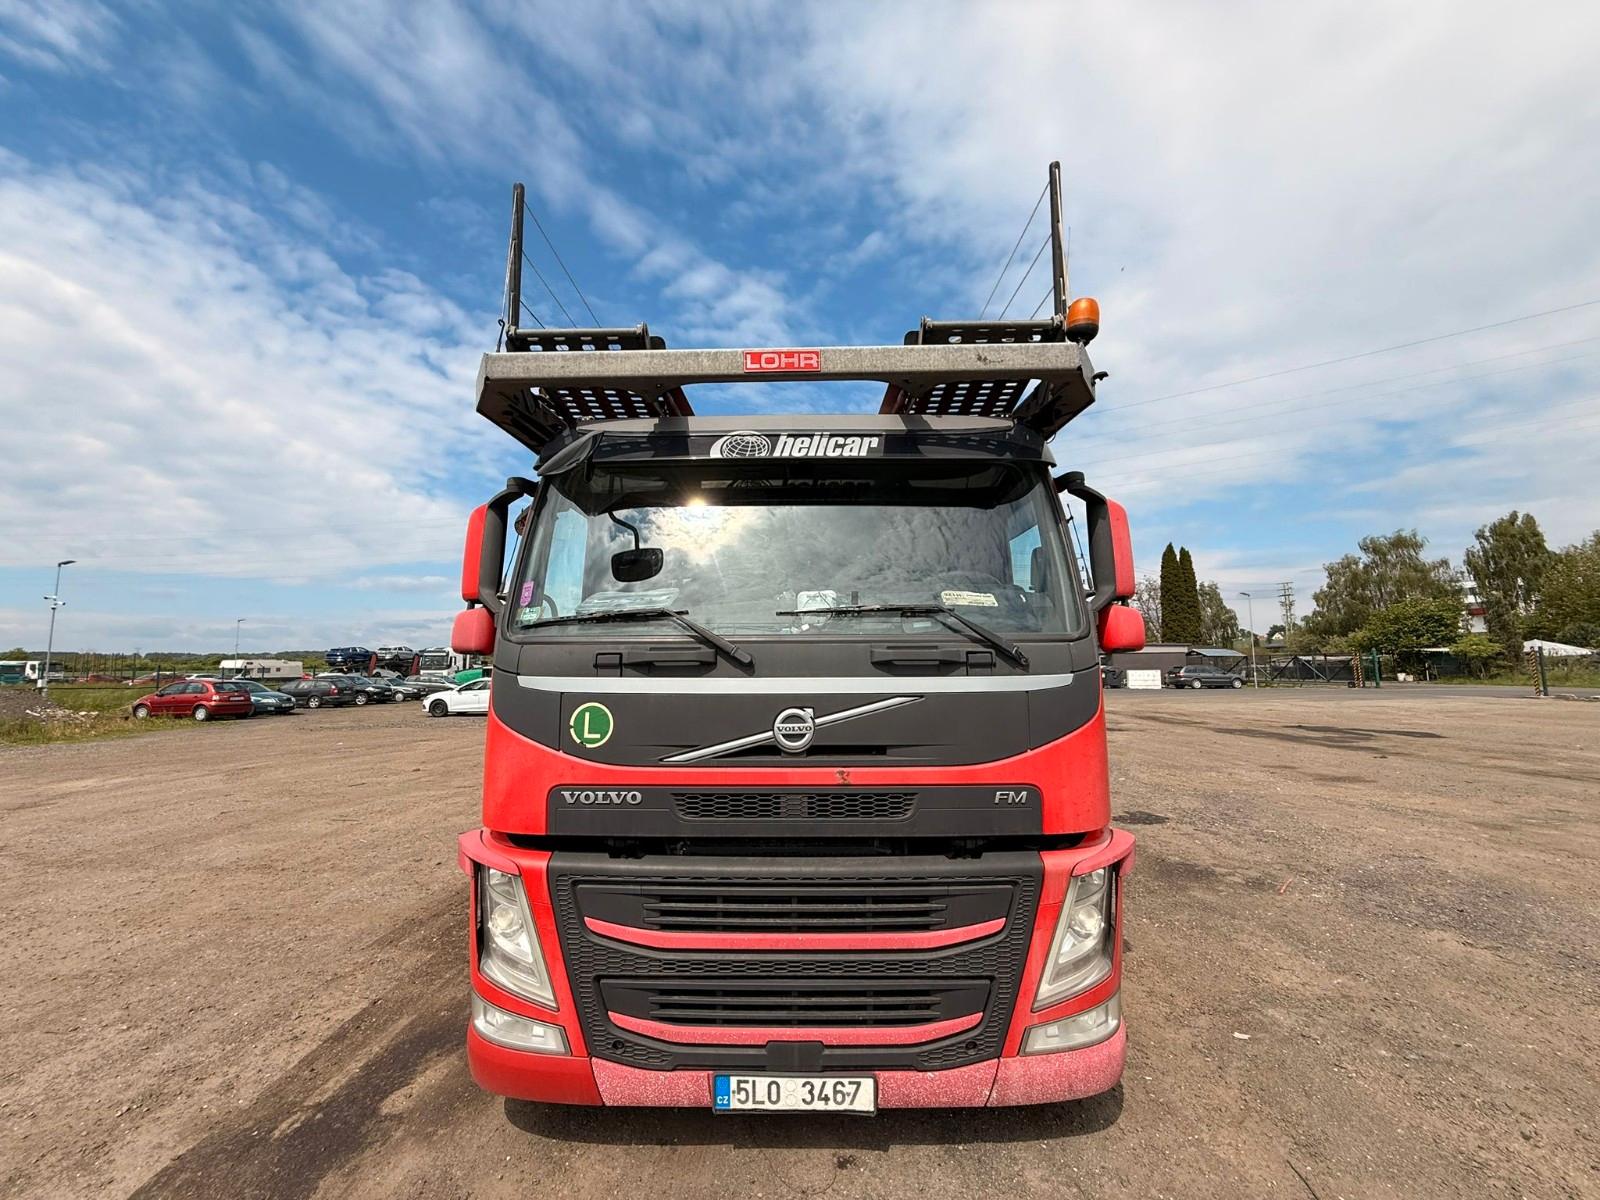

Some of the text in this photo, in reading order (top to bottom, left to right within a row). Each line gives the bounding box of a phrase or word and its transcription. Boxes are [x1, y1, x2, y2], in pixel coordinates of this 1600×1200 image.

[746, 353, 818, 369] LOHR
[772, 432, 879, 457] helicar
[583, 711, 601, 738] L
[561, 791, 642, 804] VOLVO
[994, 791, 1027, 803] FM
[717, 1096, 728, 1104] CZ
[801, 1081, 862, 1106] 3467
